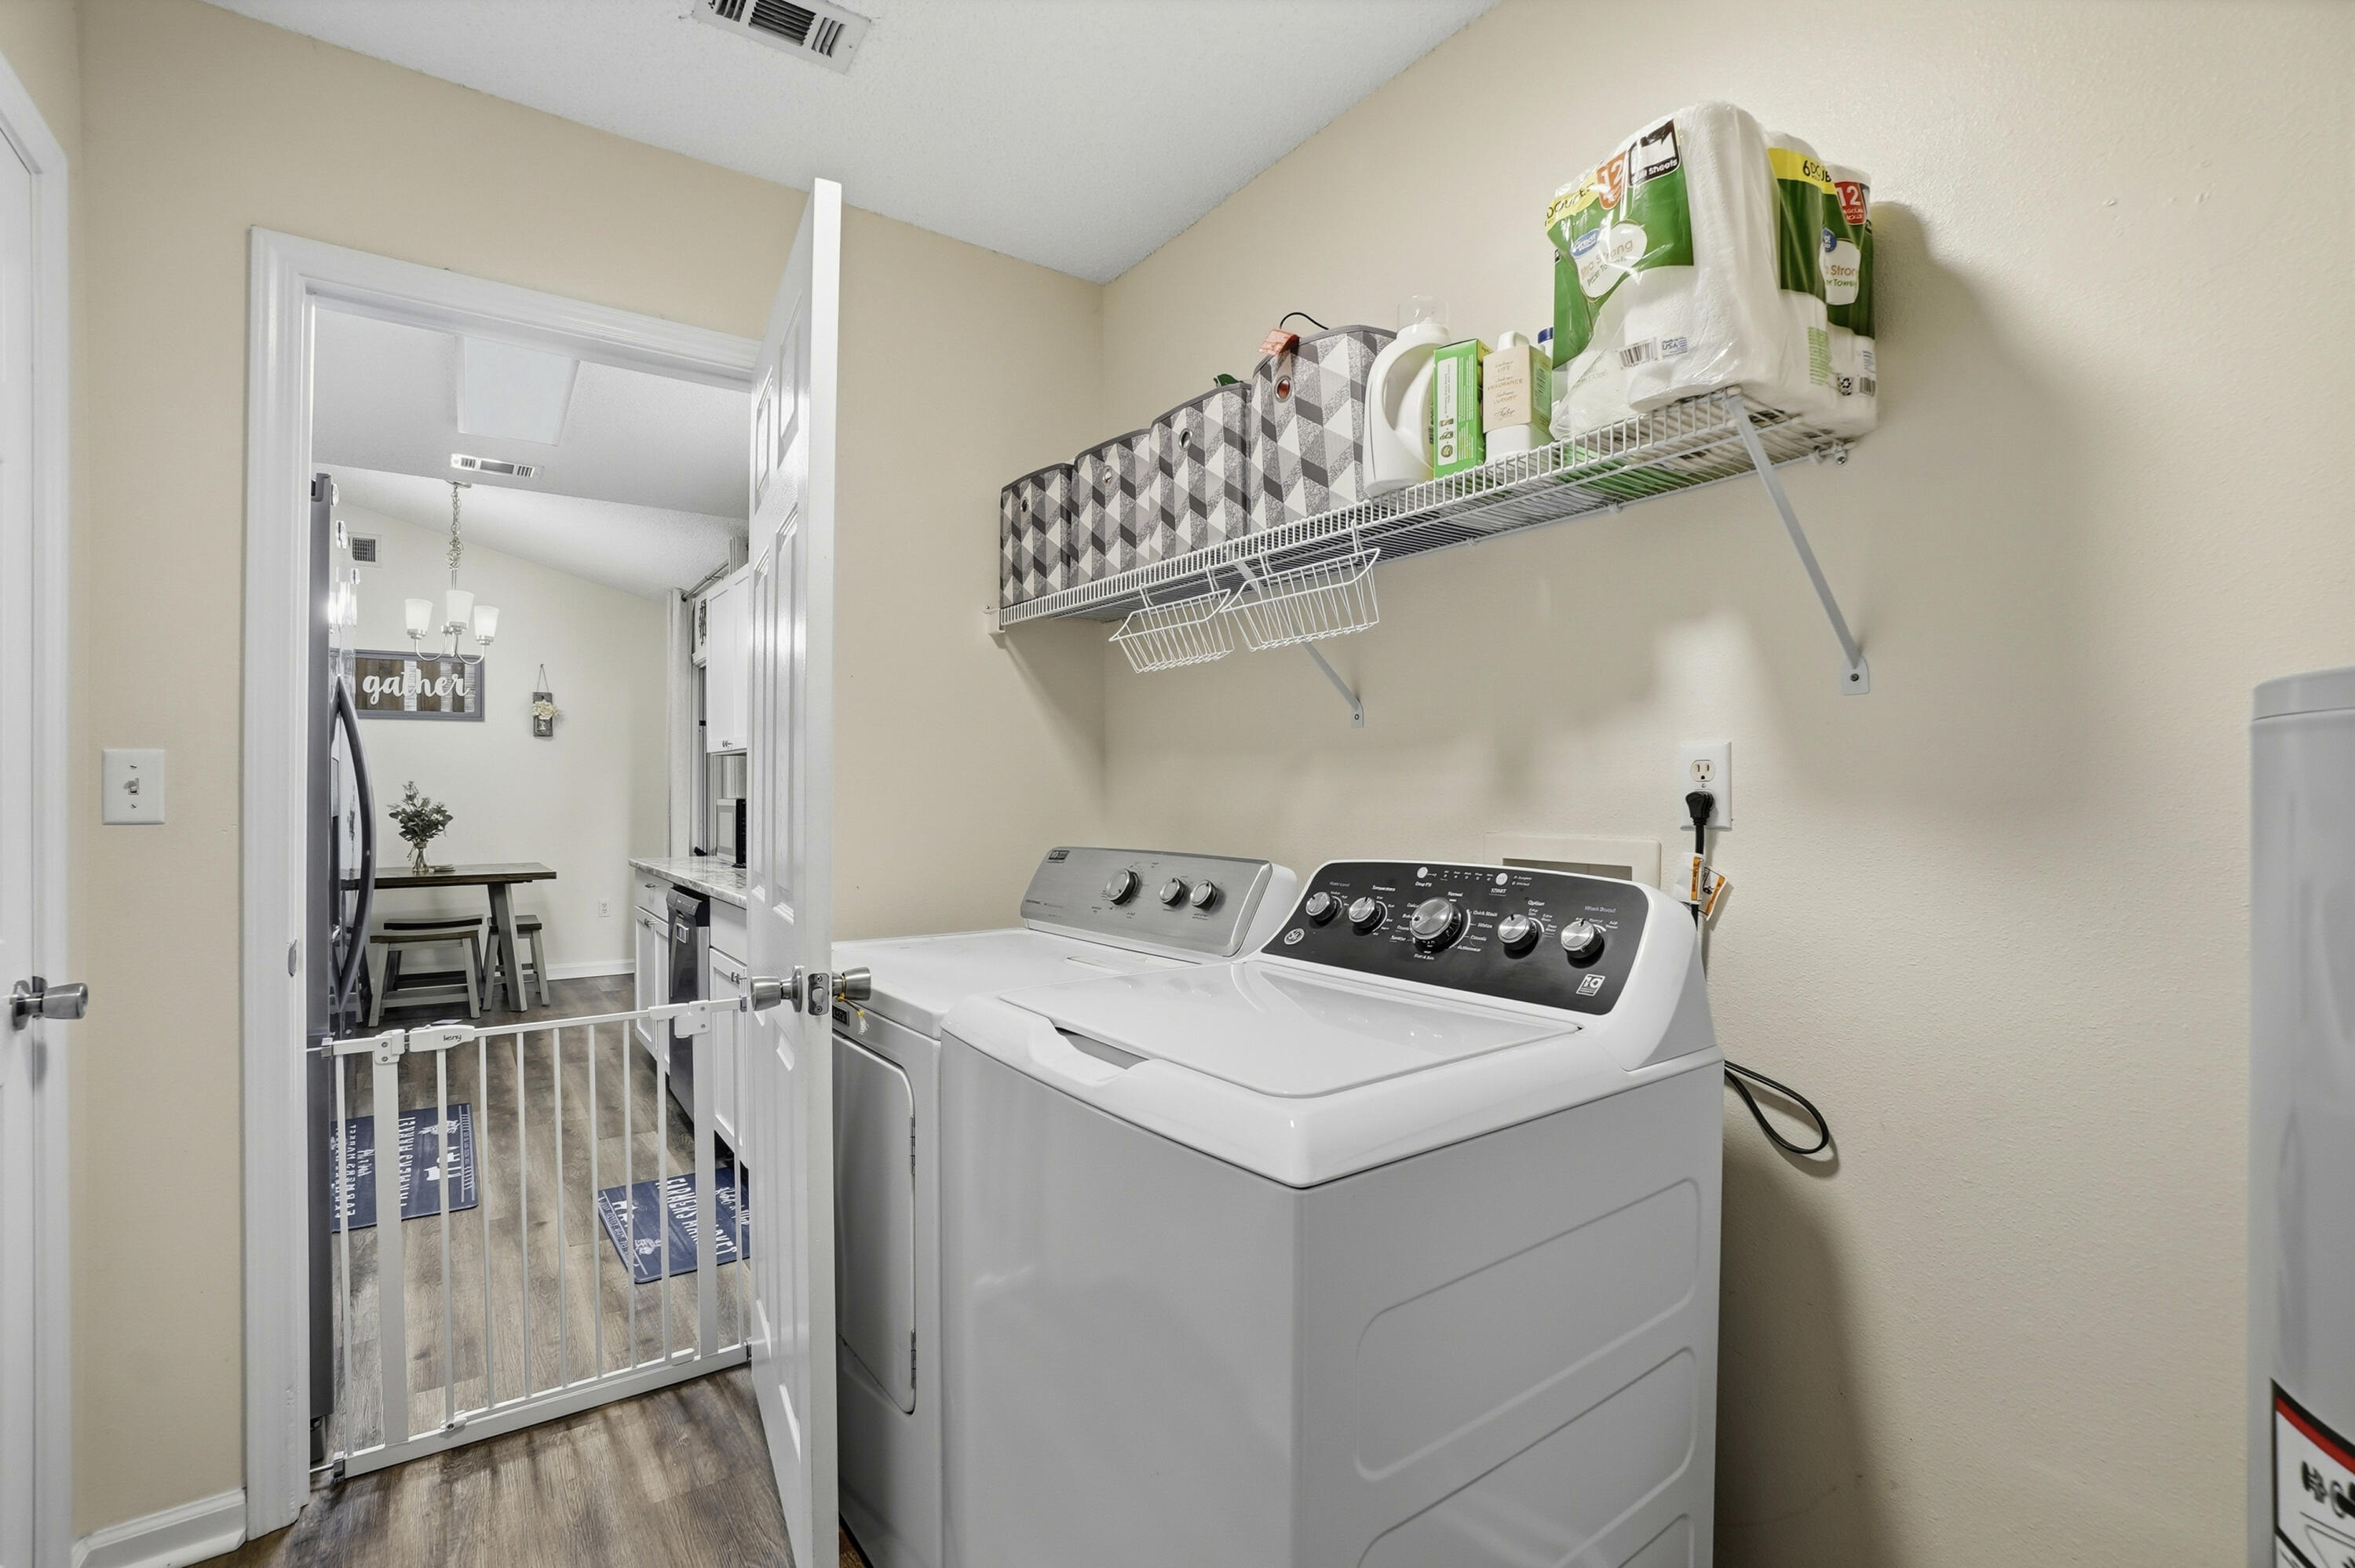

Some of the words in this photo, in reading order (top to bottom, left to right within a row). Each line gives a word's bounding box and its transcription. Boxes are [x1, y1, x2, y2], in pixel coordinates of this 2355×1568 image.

[1601, 159, 1623, 189] 12
[1802, 160, 1811, 177] 6
[1836, 185, 1861, 206] 12
[362, 668, 472, 706] gather
